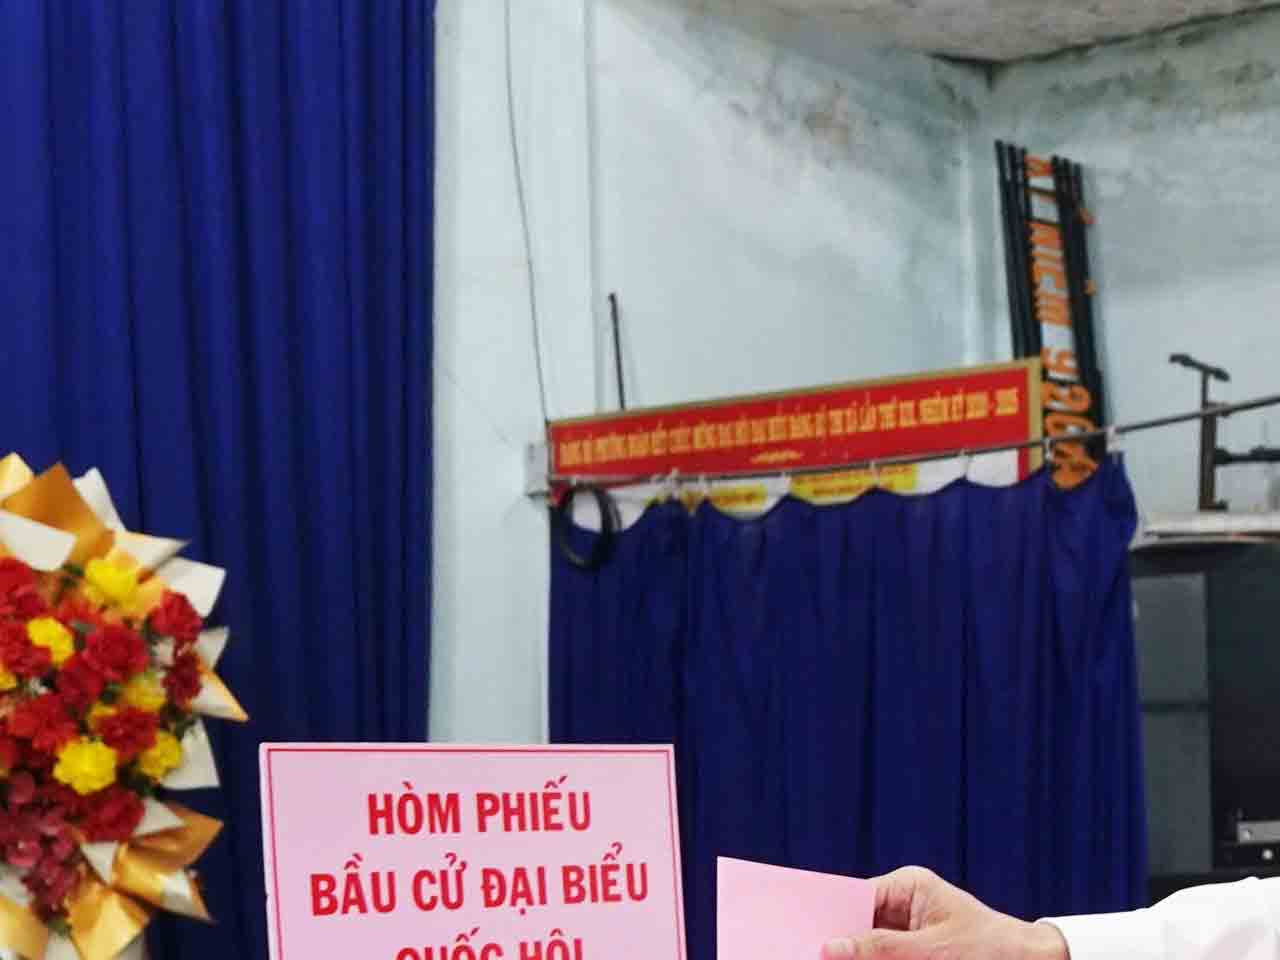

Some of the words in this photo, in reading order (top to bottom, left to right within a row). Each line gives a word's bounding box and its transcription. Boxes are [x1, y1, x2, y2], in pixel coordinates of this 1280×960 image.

[367, 781, 462, 836] HÒM
[475, 775, 592, 833] PHIẾU
[310, 853, 398, 917] BẦU
[411, 852, 468, 912] CỬ
[480, 865, 548, 916] ĐẠI
[561, 842, 649, 905] BIỂU
